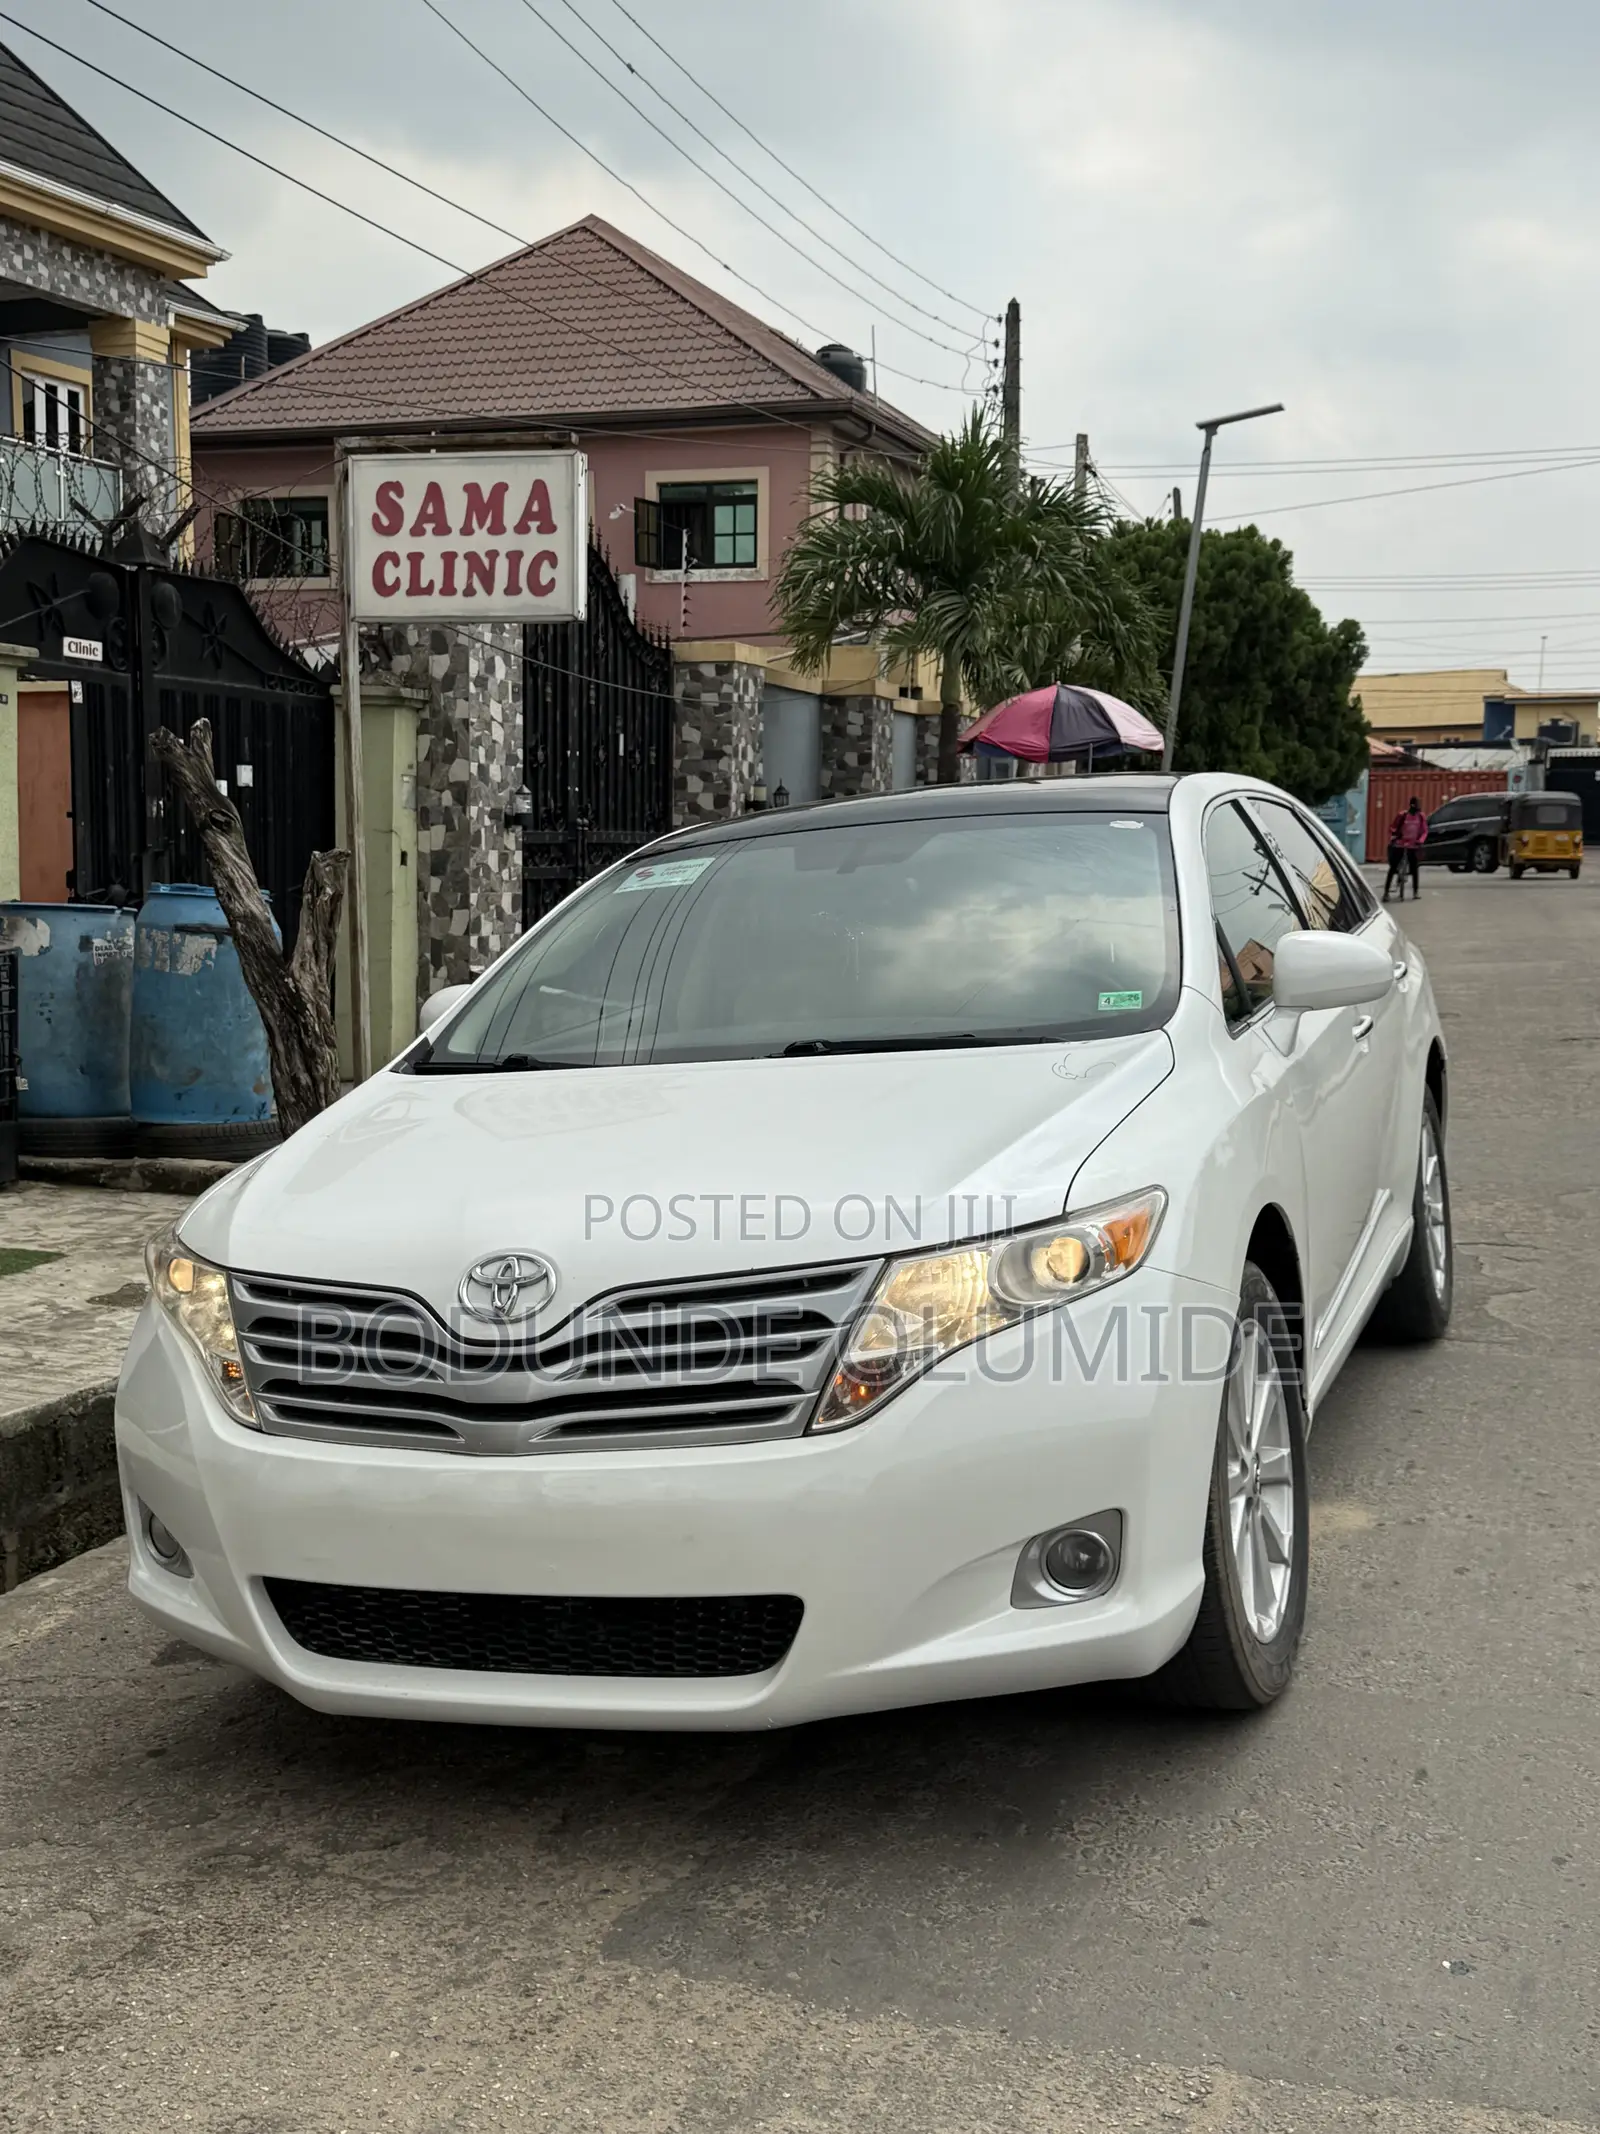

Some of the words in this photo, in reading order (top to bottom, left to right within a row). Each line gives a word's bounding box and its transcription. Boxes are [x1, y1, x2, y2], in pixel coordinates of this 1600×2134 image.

[371, 478, 558, 538] SAMA
[371, 549, 559, 598] CLINIC
[67, 640, 99, 657] Clinic
